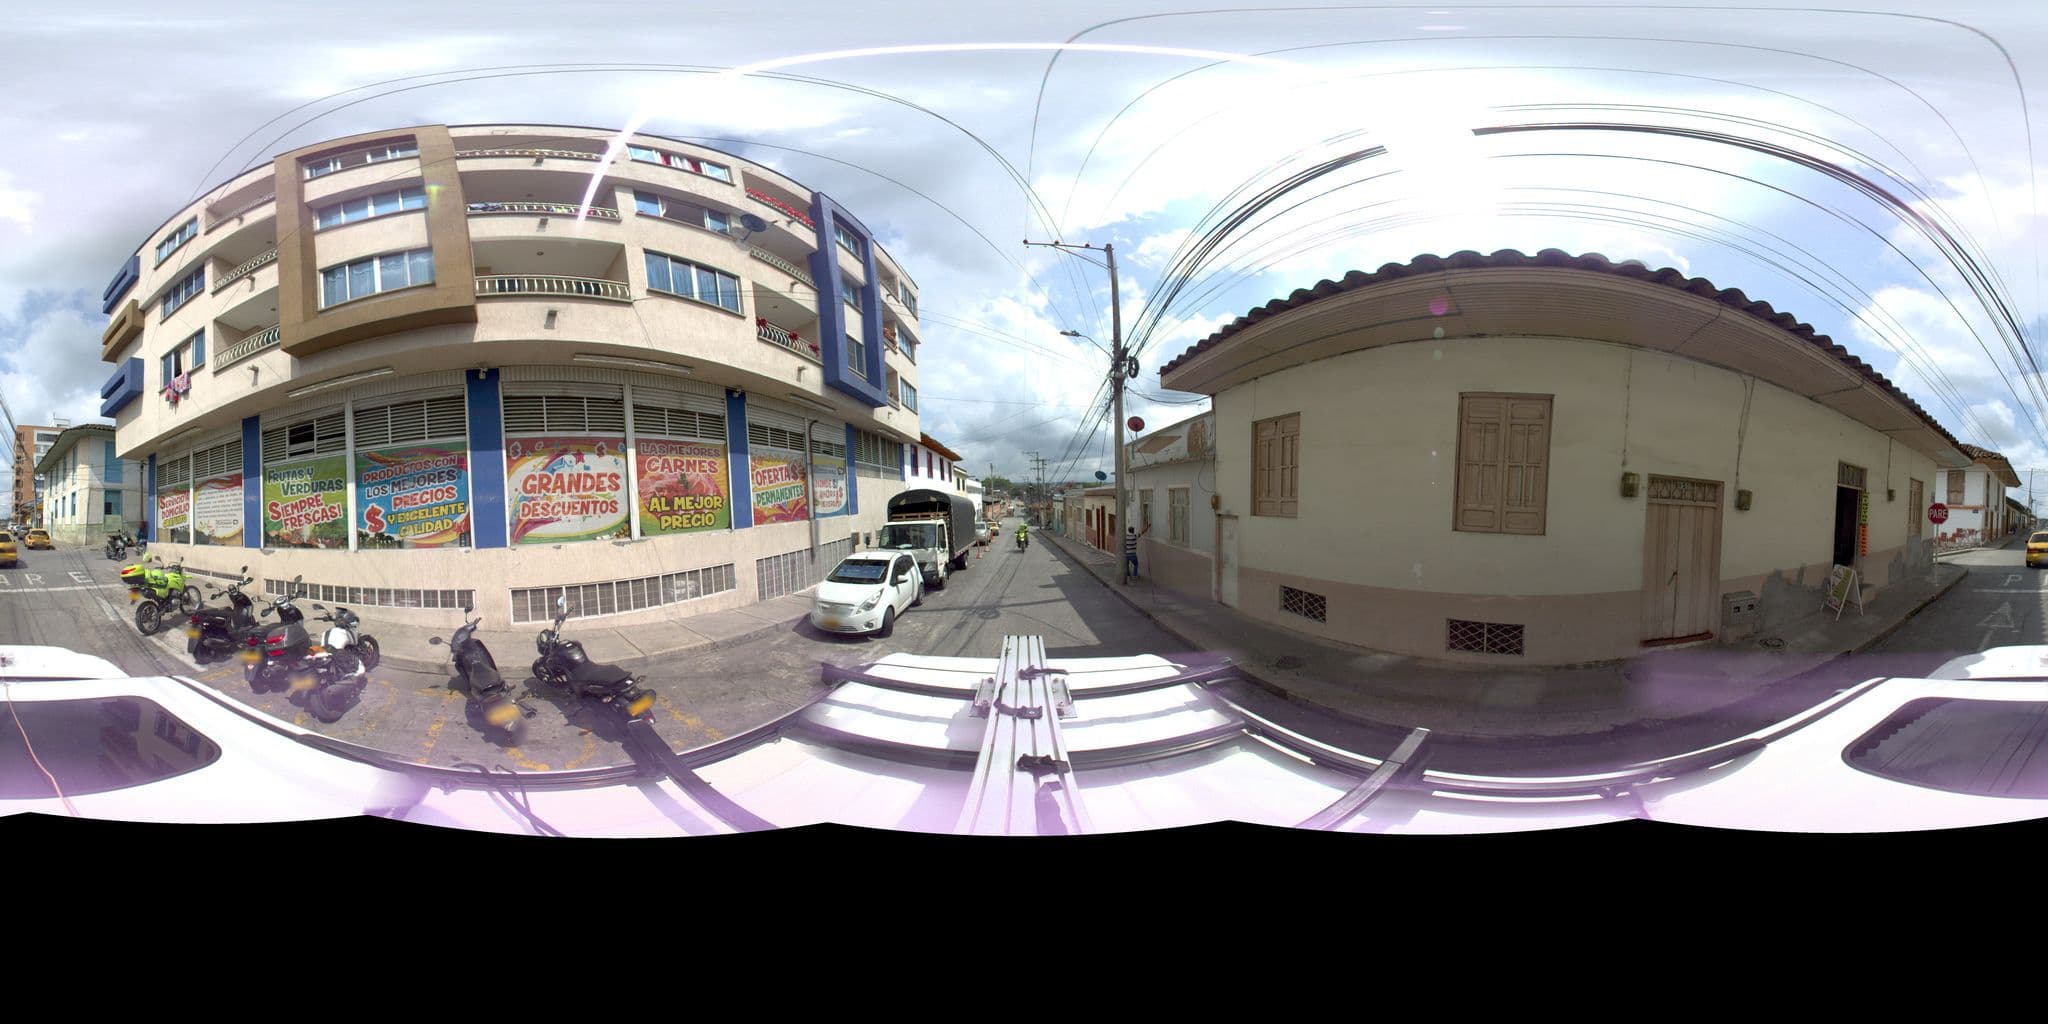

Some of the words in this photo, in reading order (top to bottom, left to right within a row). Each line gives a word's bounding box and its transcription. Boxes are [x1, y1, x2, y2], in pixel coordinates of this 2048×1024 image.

[641, 443, 665, 455] LAS
[669, 445, 721, 457] MEJORES
[363, 460, 433, 483] PRODUCTOS
[435, 455, 457, 467] CON
[646, 457, 719, 473] CARNES
[268, 469, 305, 483] FRUTAS
[306, 467, 314, 479] Y
[366, 485, 388, 498] LOS
[391, 469, 457, 493] MEJORES
[521, 472, 621, 495] GRANDES
[281, 478, 344, 496] VERDURAS
[756, 484, 804, 506] PERMANENTES
[269, 493, 323, 520] SIEMPRE
[393, 486, 457, 510] PRECIOS
[649, 496, 671, 512] AL
[673, 496, 724, 511] MEJOR
[162, 502, 190, 519] DOMICILIO
[283, 504, 343, 530] FRESCAS!
[387, 514, 395, 524] Y
[397, 503, 466, 523] EXCELENTE
[521, 500, 619, 518] DESCUENTOS
[1929, 509, 1948, 520] PARE
[400, 519, 453, 537] CALIDAD
[660, 513, 715, 530] PRECIO
